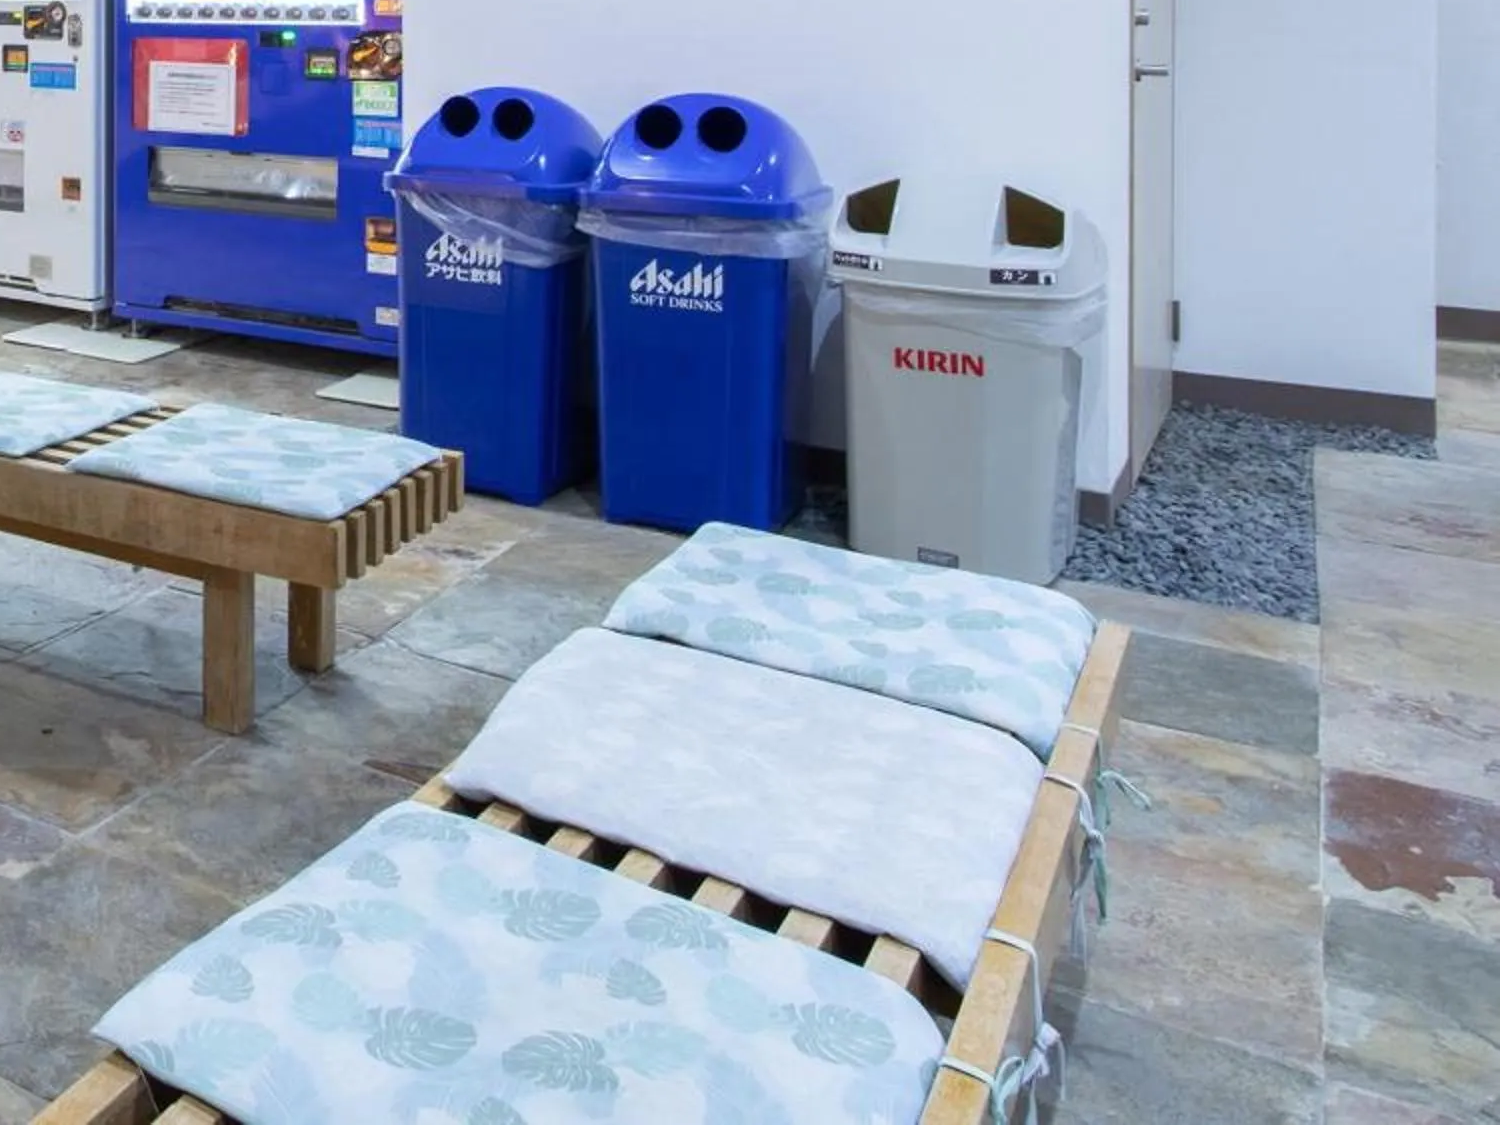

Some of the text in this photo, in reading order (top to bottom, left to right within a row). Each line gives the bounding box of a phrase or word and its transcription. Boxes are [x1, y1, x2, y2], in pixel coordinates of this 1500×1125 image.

[425, 231, 502, 268] Asahi
[629, 258, 723, 300] Asahi
[630, 293, 723, 313] SOFT DRINKS
[894, 347, 984, 378] KIRIN
